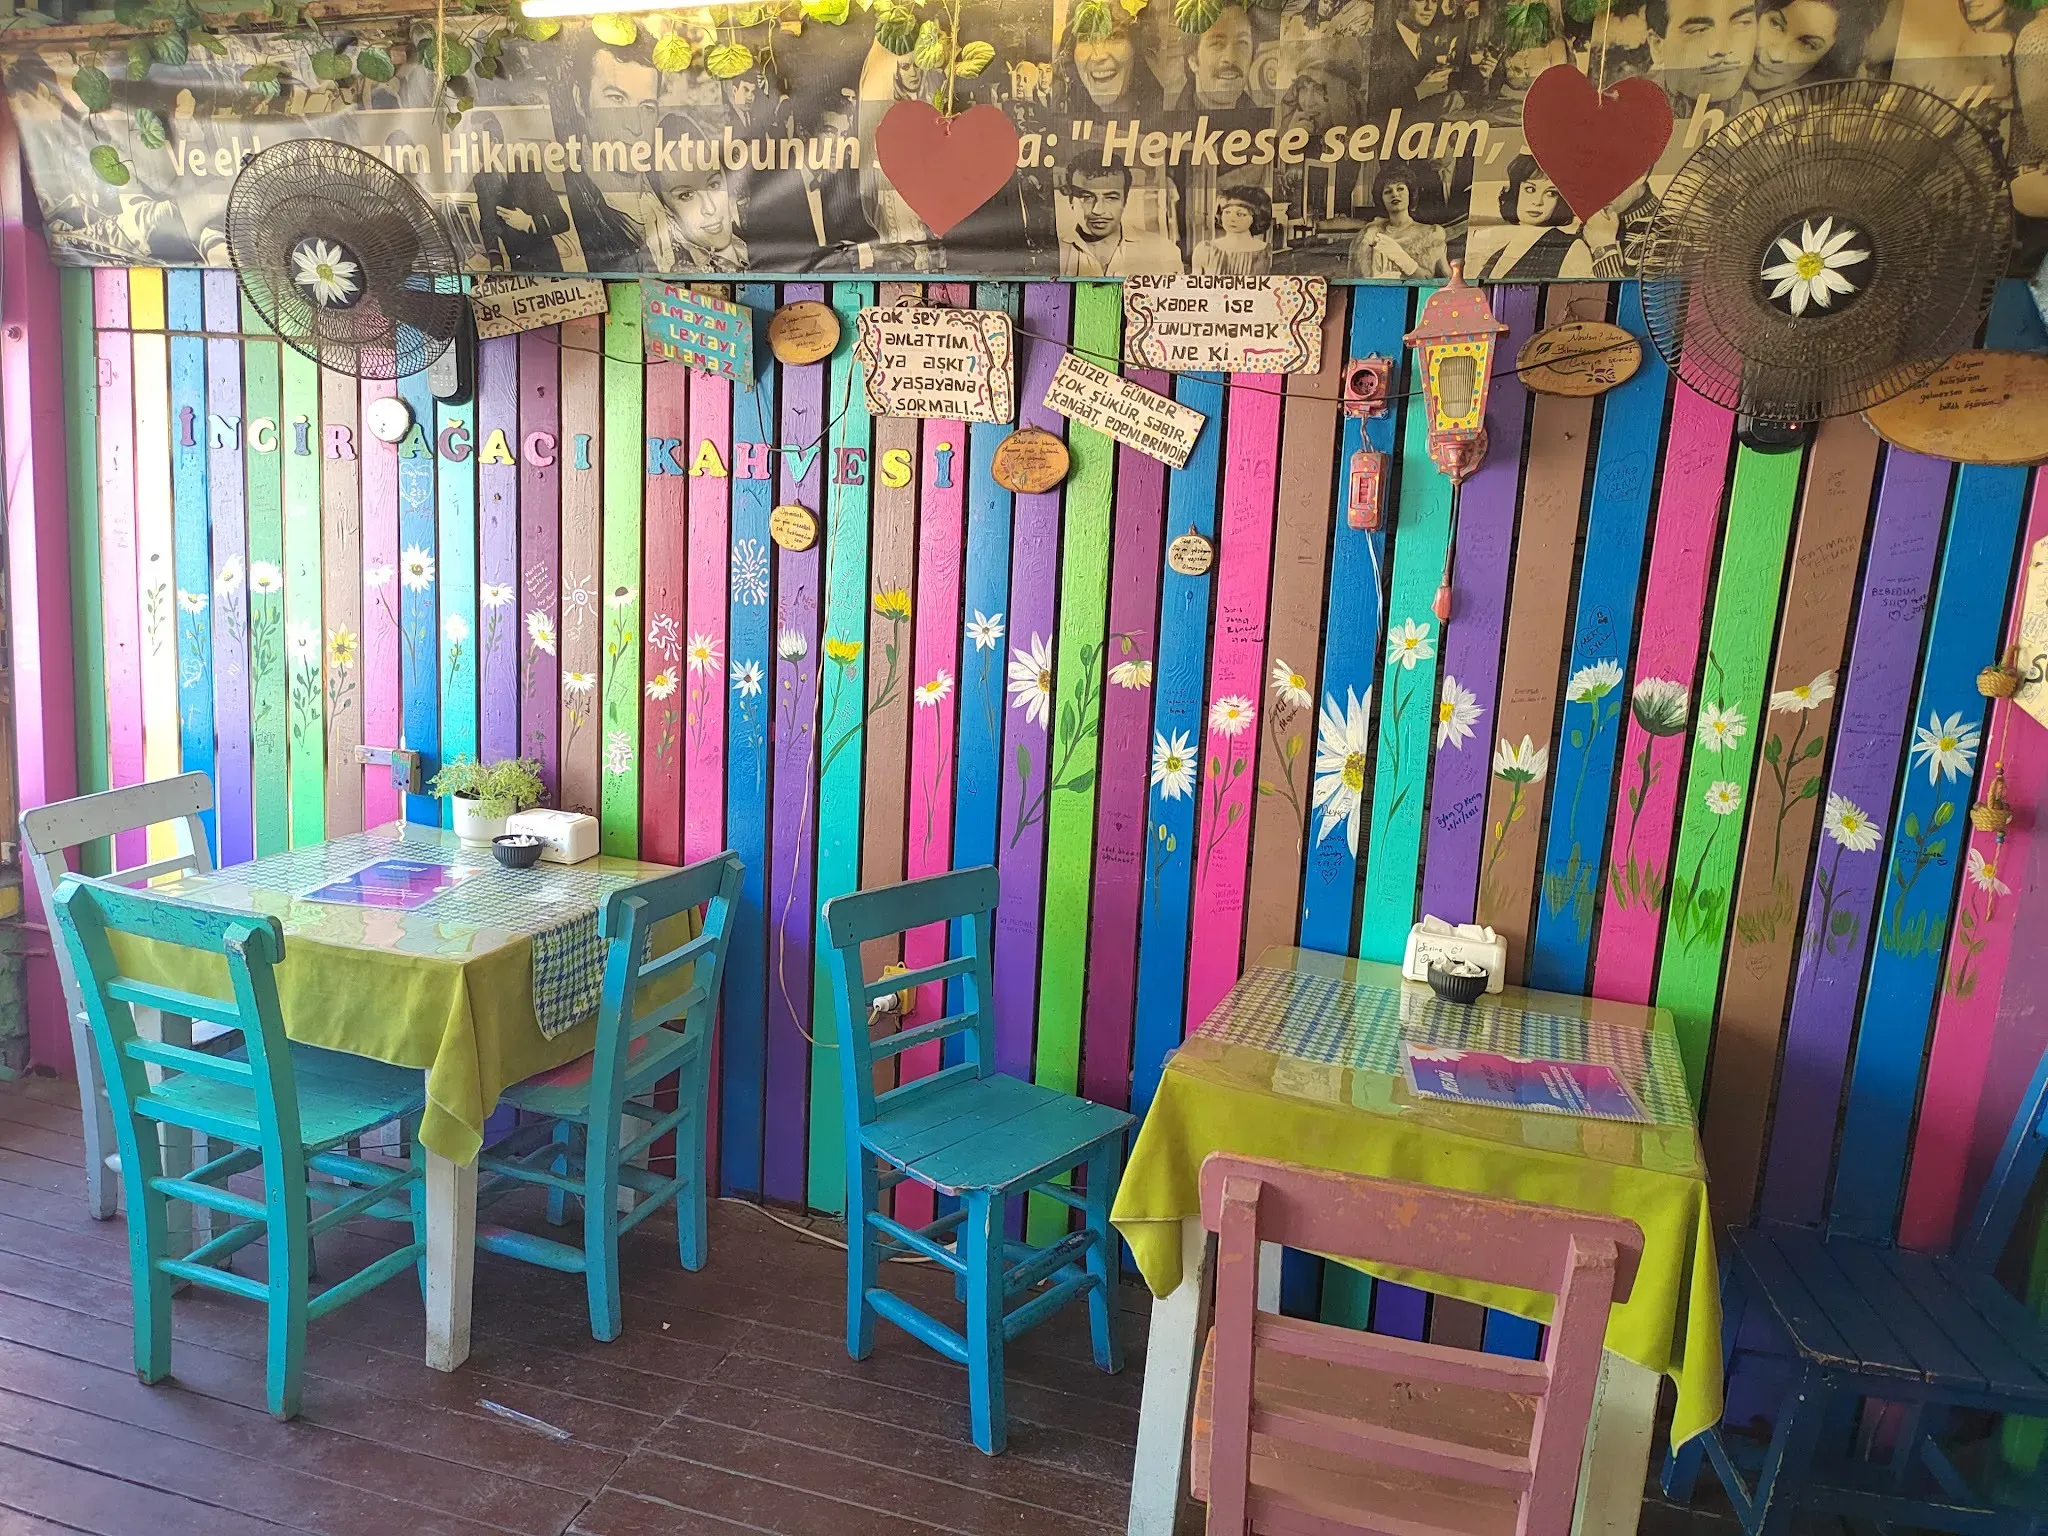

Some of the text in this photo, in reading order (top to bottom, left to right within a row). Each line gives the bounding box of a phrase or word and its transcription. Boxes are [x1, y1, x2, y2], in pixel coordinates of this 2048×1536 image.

[442, 130, 581, 173] Hikmet
[593, 126, 860, 172] mektubunun
[1319, 109, 1504, 167] selam,
[1156, 299, 1209, 313] KADER
[1159, 323, 1279, 339] UNUTAMAMAK
[884, 354, 906, 369] YA
[1171, 346, 1199, 361] NE
[1068, 357, 1112, 388] GÜZEL
[1120, 383, 1178, 420] GÜNLER
[179, 406, 358, 461] İNCİR
[400, 418, 592, 471] AĞACI
[646, 438, 955, 488] KAHVESİ
